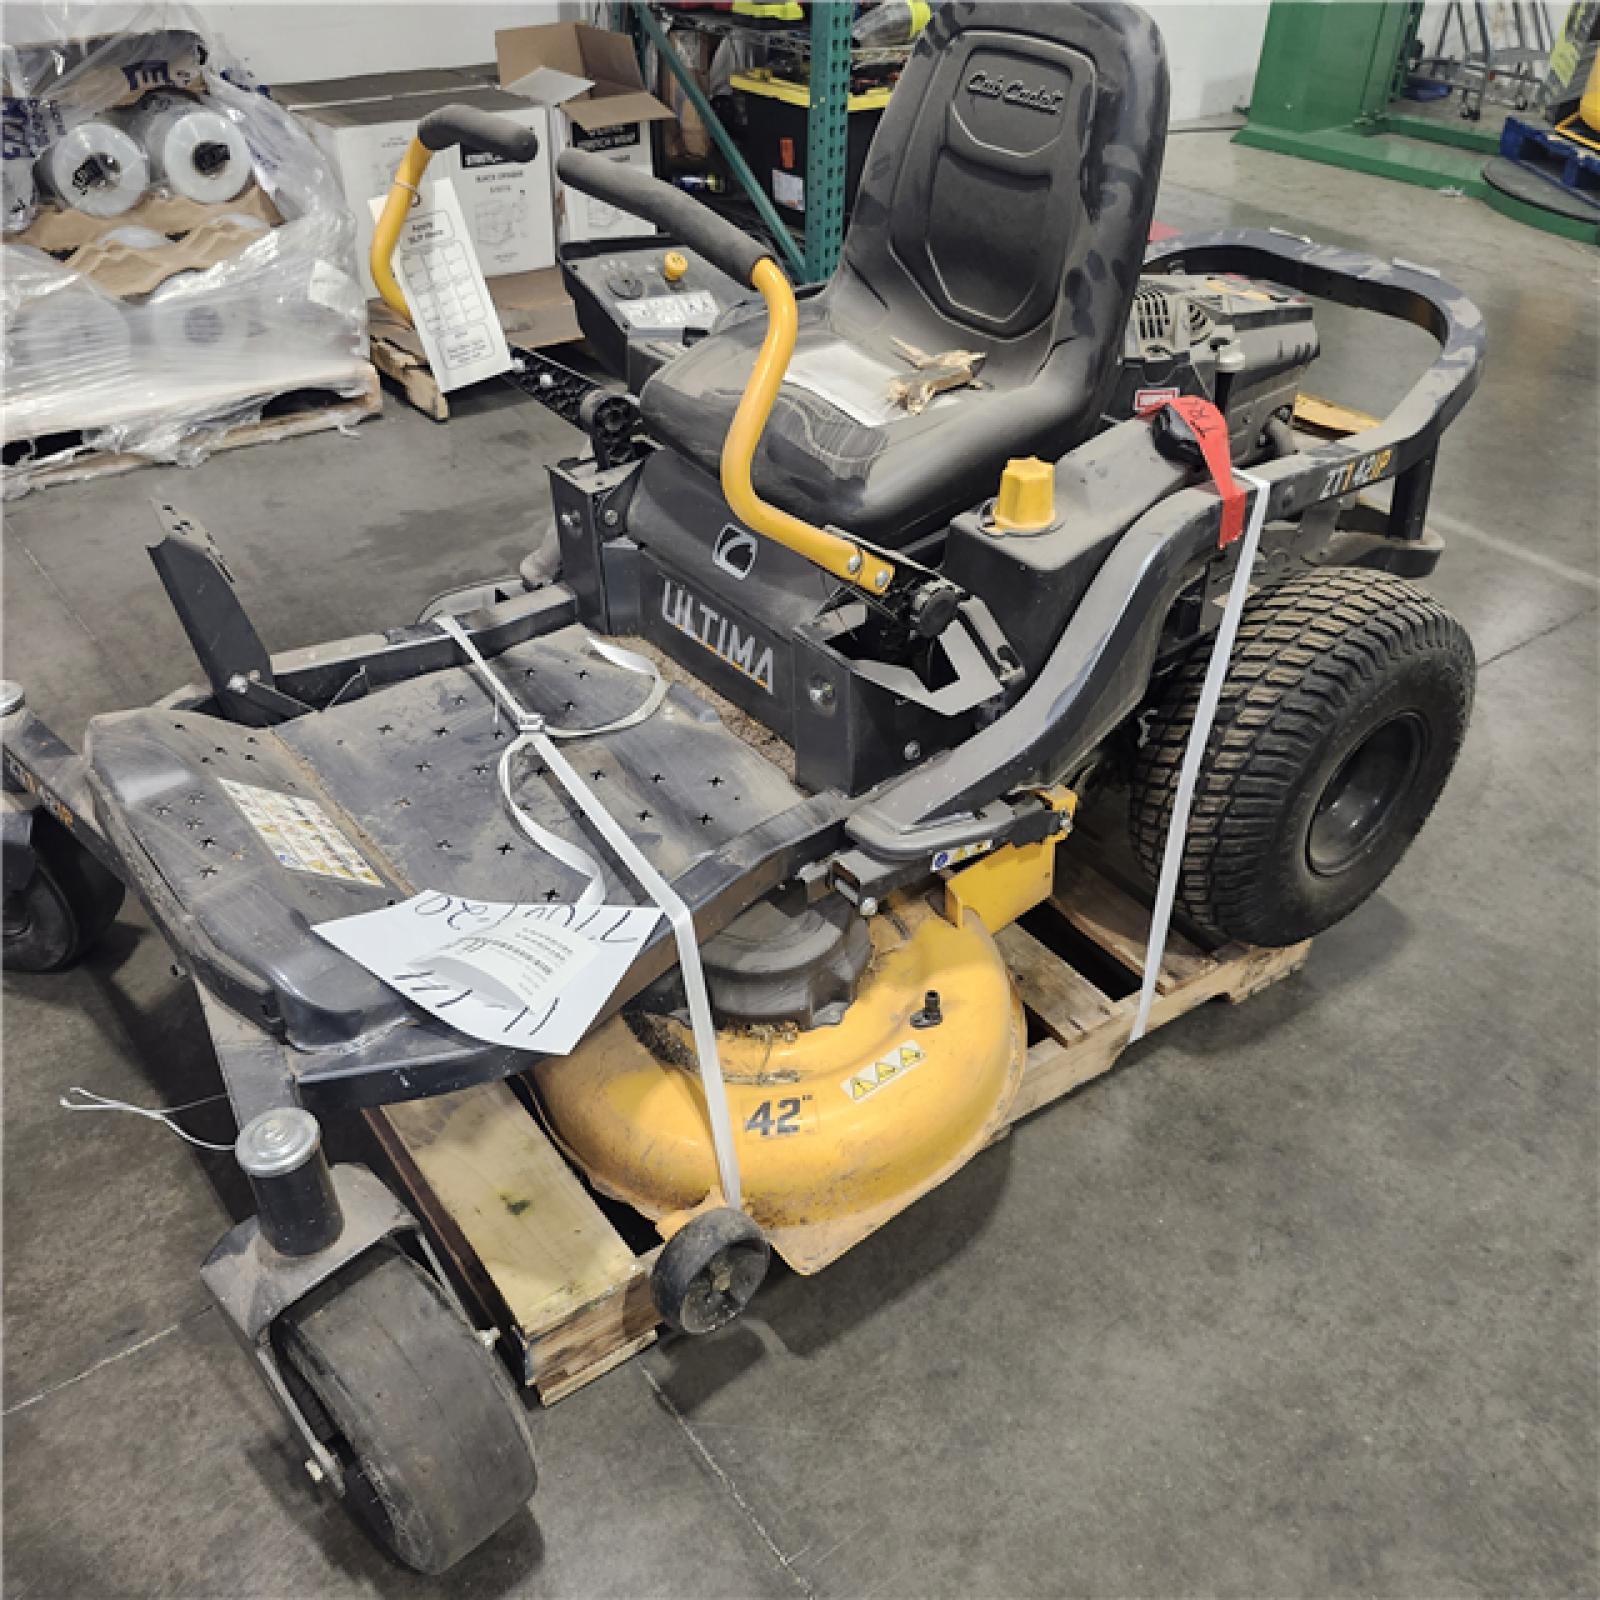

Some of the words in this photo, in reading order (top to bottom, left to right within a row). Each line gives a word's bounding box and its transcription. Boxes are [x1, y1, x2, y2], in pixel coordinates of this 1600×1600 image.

[968, 70, 1004, 98] Cub
[1003, 80, 1064, 116] Cadet
[662, 579, 773, 695] ULTIMA
